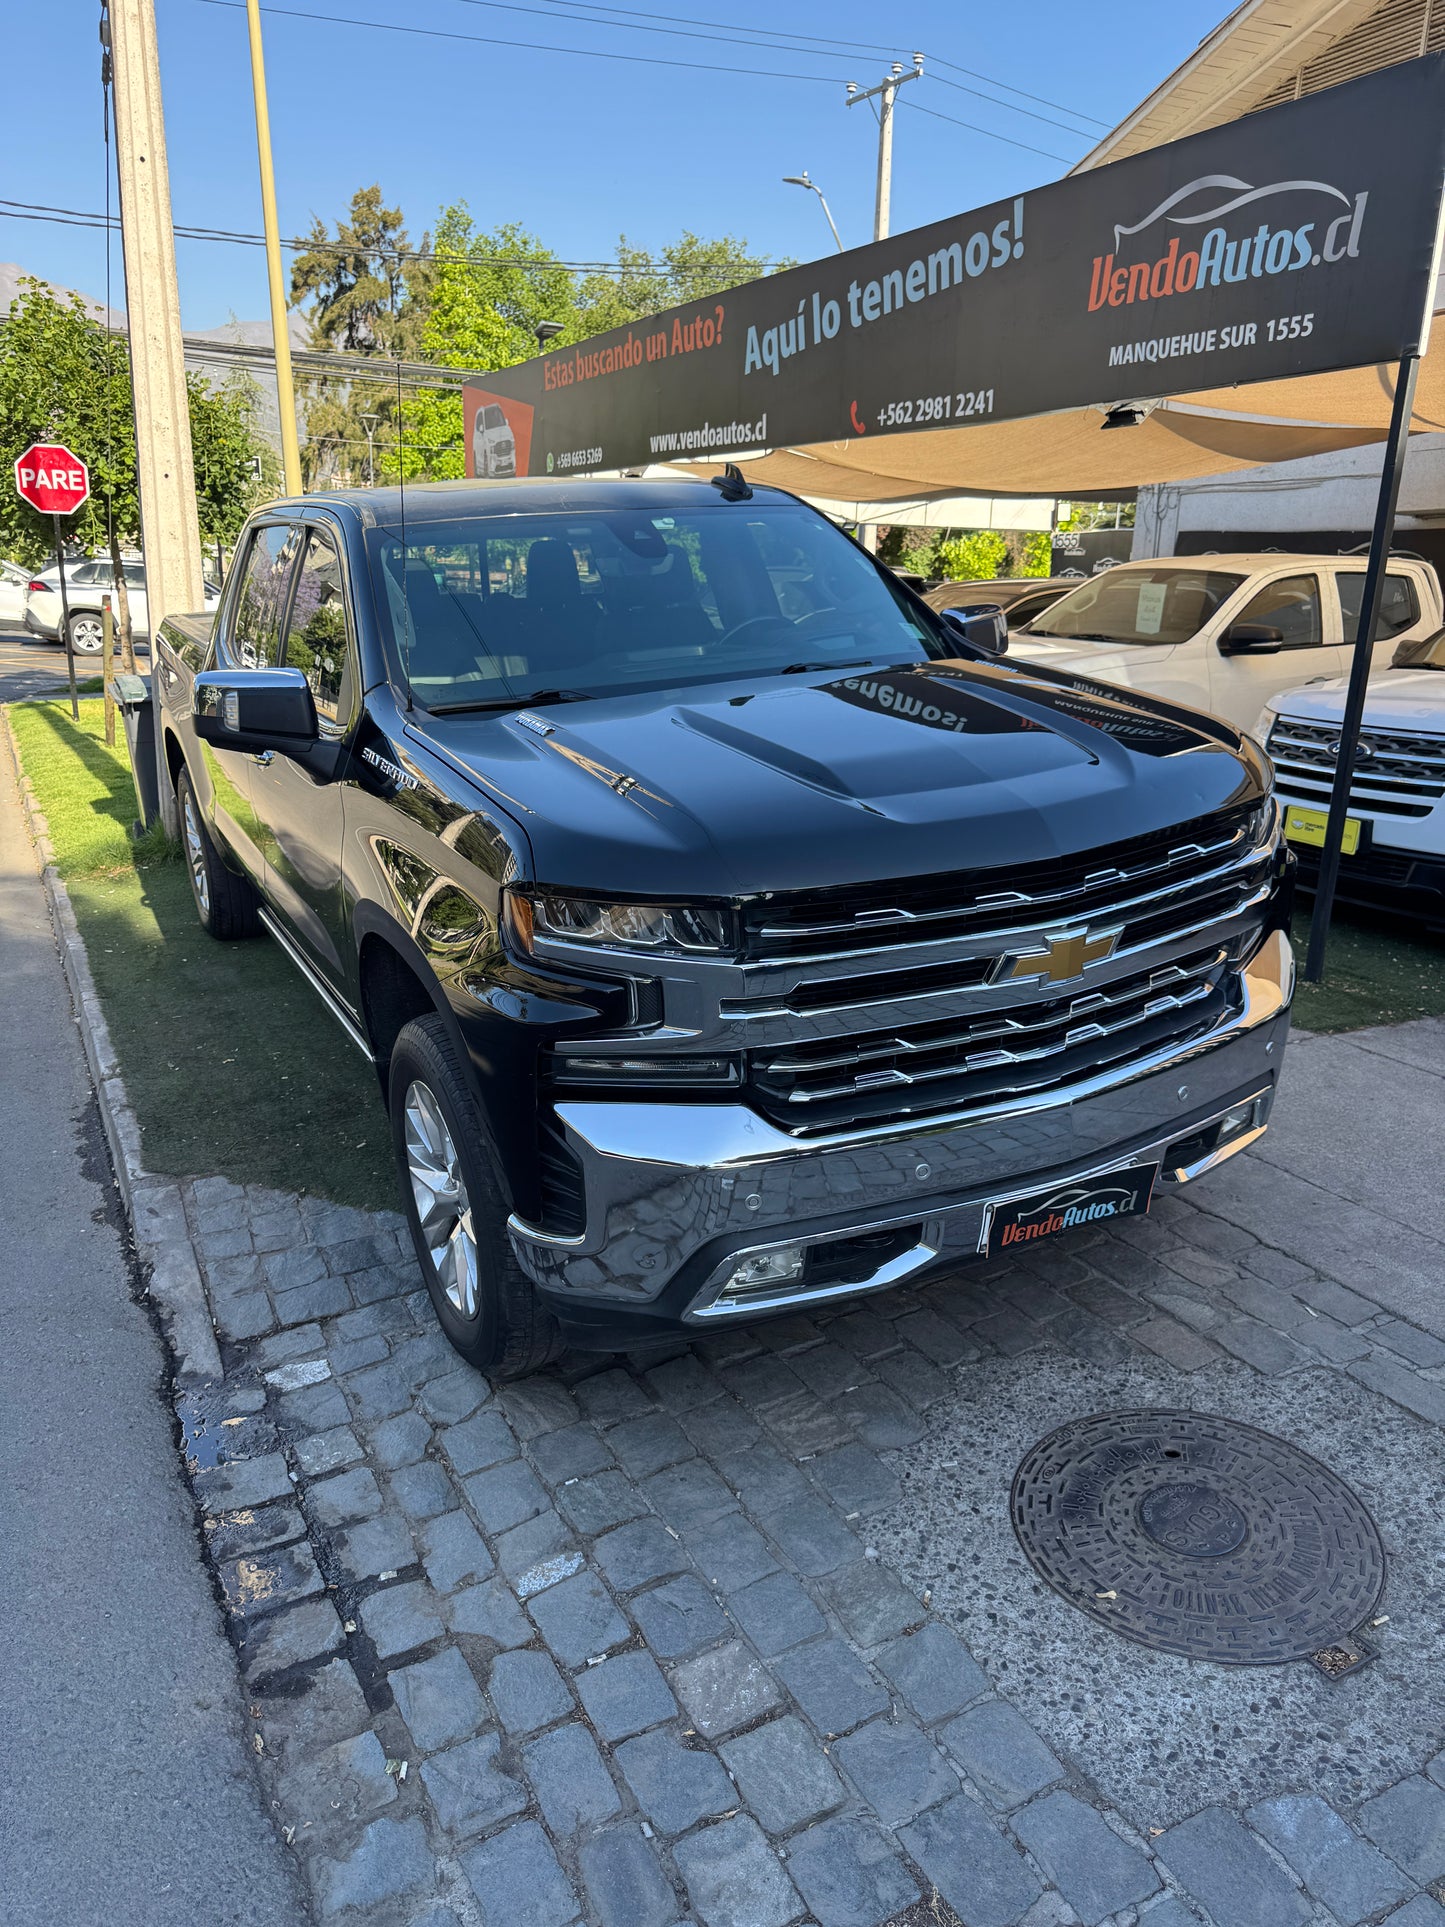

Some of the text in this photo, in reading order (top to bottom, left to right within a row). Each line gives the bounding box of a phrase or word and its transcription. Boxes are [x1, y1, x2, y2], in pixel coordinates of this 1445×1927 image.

[1087, 191, 1369, 312] VendoAutos.cl
[744, 197, 1025, 376] Aquí lo tenemos!
[543, 305, 725, 391] Estas buscando un Auto?
[1108, 313, 1314, 367] MANQUEHUE SUR 1555
[650, 413, 767, 453] www.vendoautos.cl
[877, 389, 994, 427] +562 2981 2241
[20, 467, 84, 491] PARE
[556, 446, 603, 469] +569 6653 5269
[1001, 1190, 1139, 1247] VendoAutos.cl
